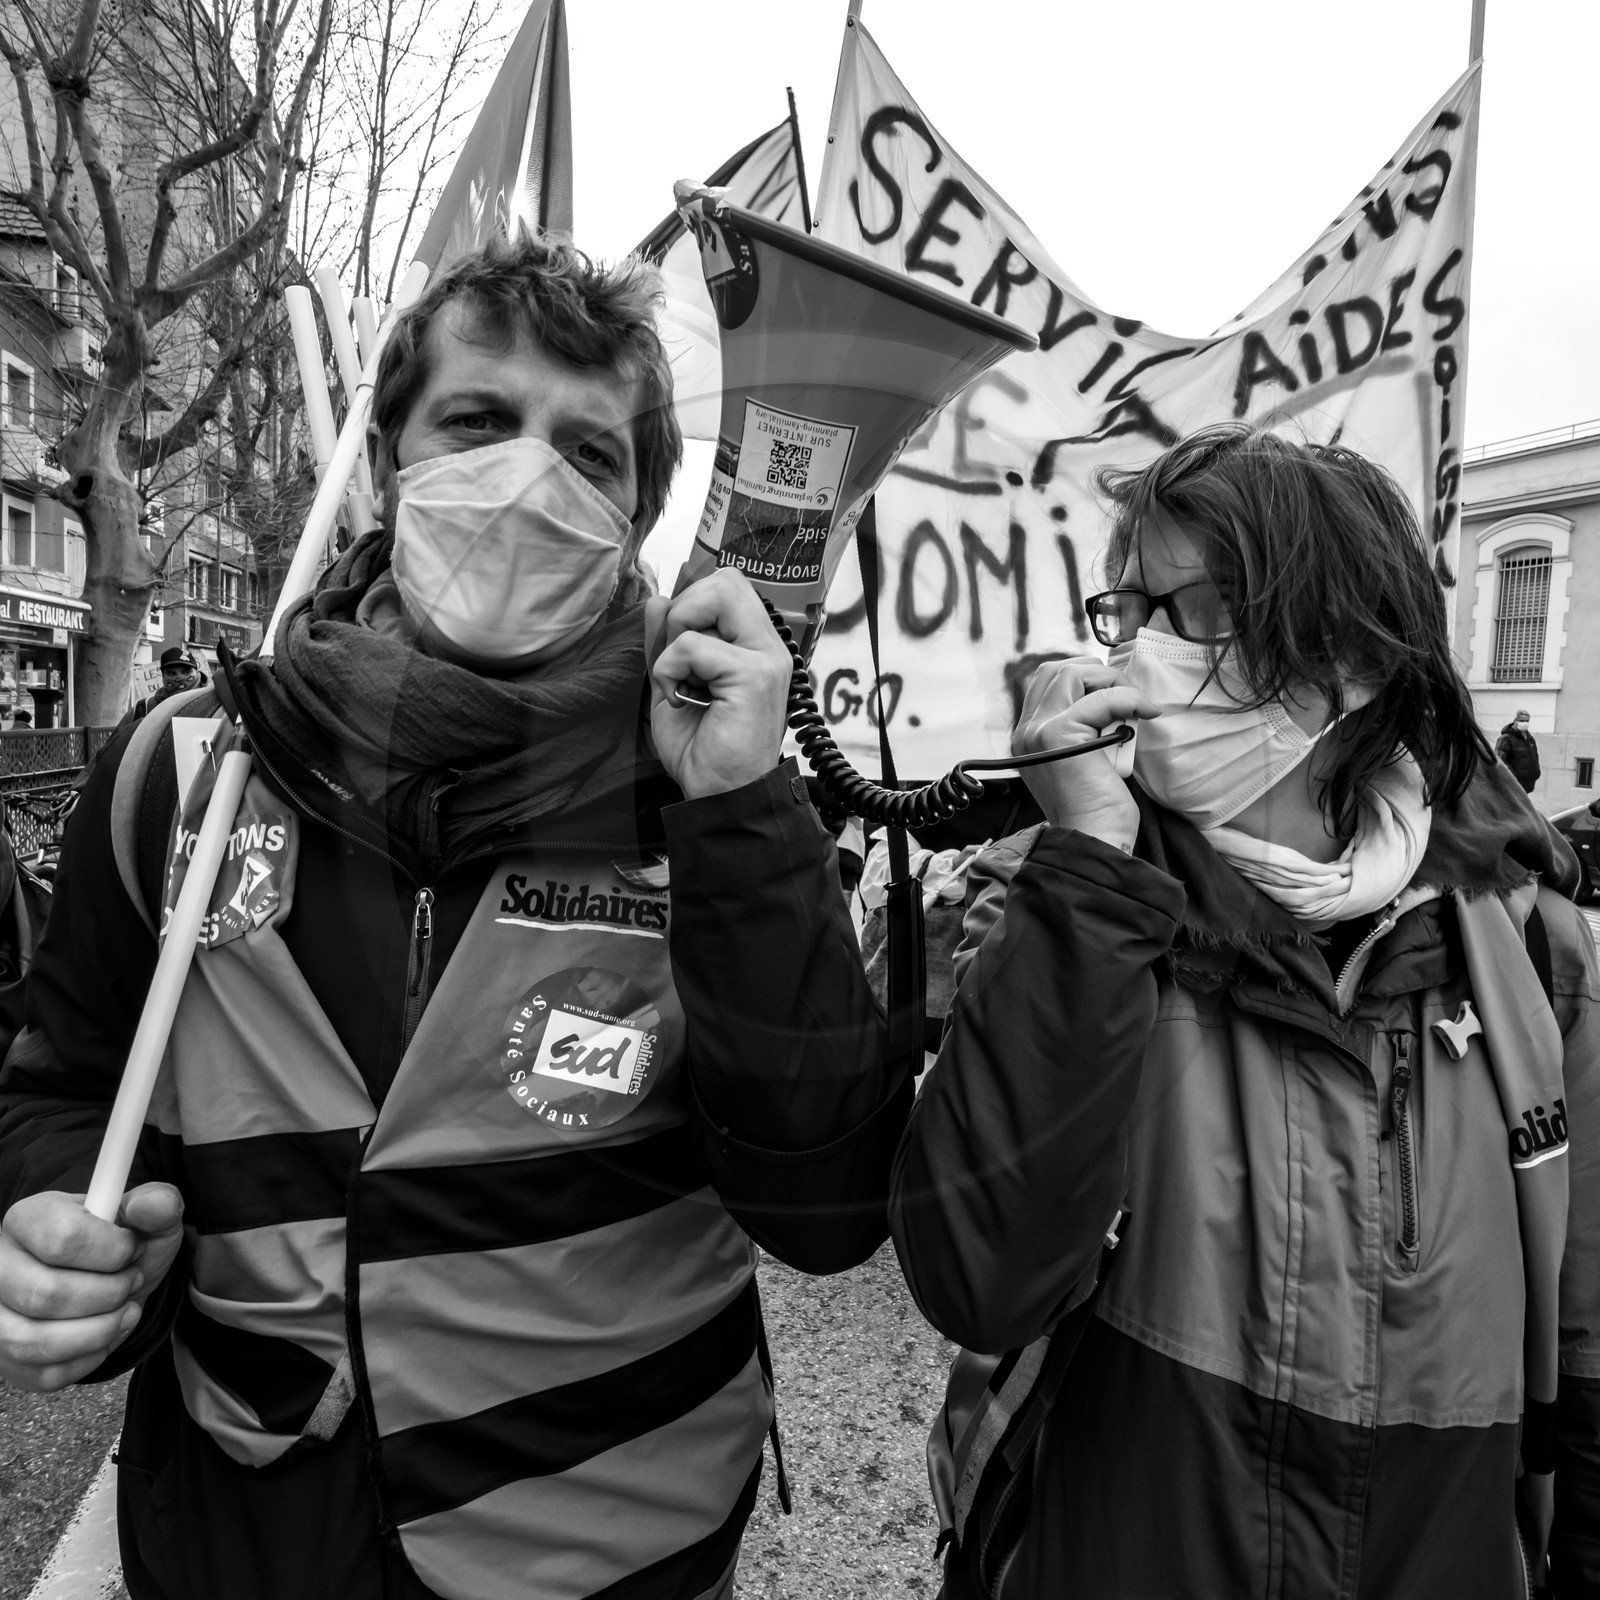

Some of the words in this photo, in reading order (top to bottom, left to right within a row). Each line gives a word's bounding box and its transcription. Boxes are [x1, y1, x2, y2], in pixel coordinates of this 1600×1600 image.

[810, 435, 832, 448] SUR
[737, 477, 767, 493] familial
[767, 485, 806, 503] planning
[796, 527, 829, 544] sida
[719, 550, 820, 581] avortement
[19, 600, 84, 630] RESTAURANT
[500, 873, 669, 930] Solidaires
[507, 994, 548, 1059] Santé
[628, 1033, 658, 1096] Solidaires
[509, 1070, 589, 1127] Sociaux
